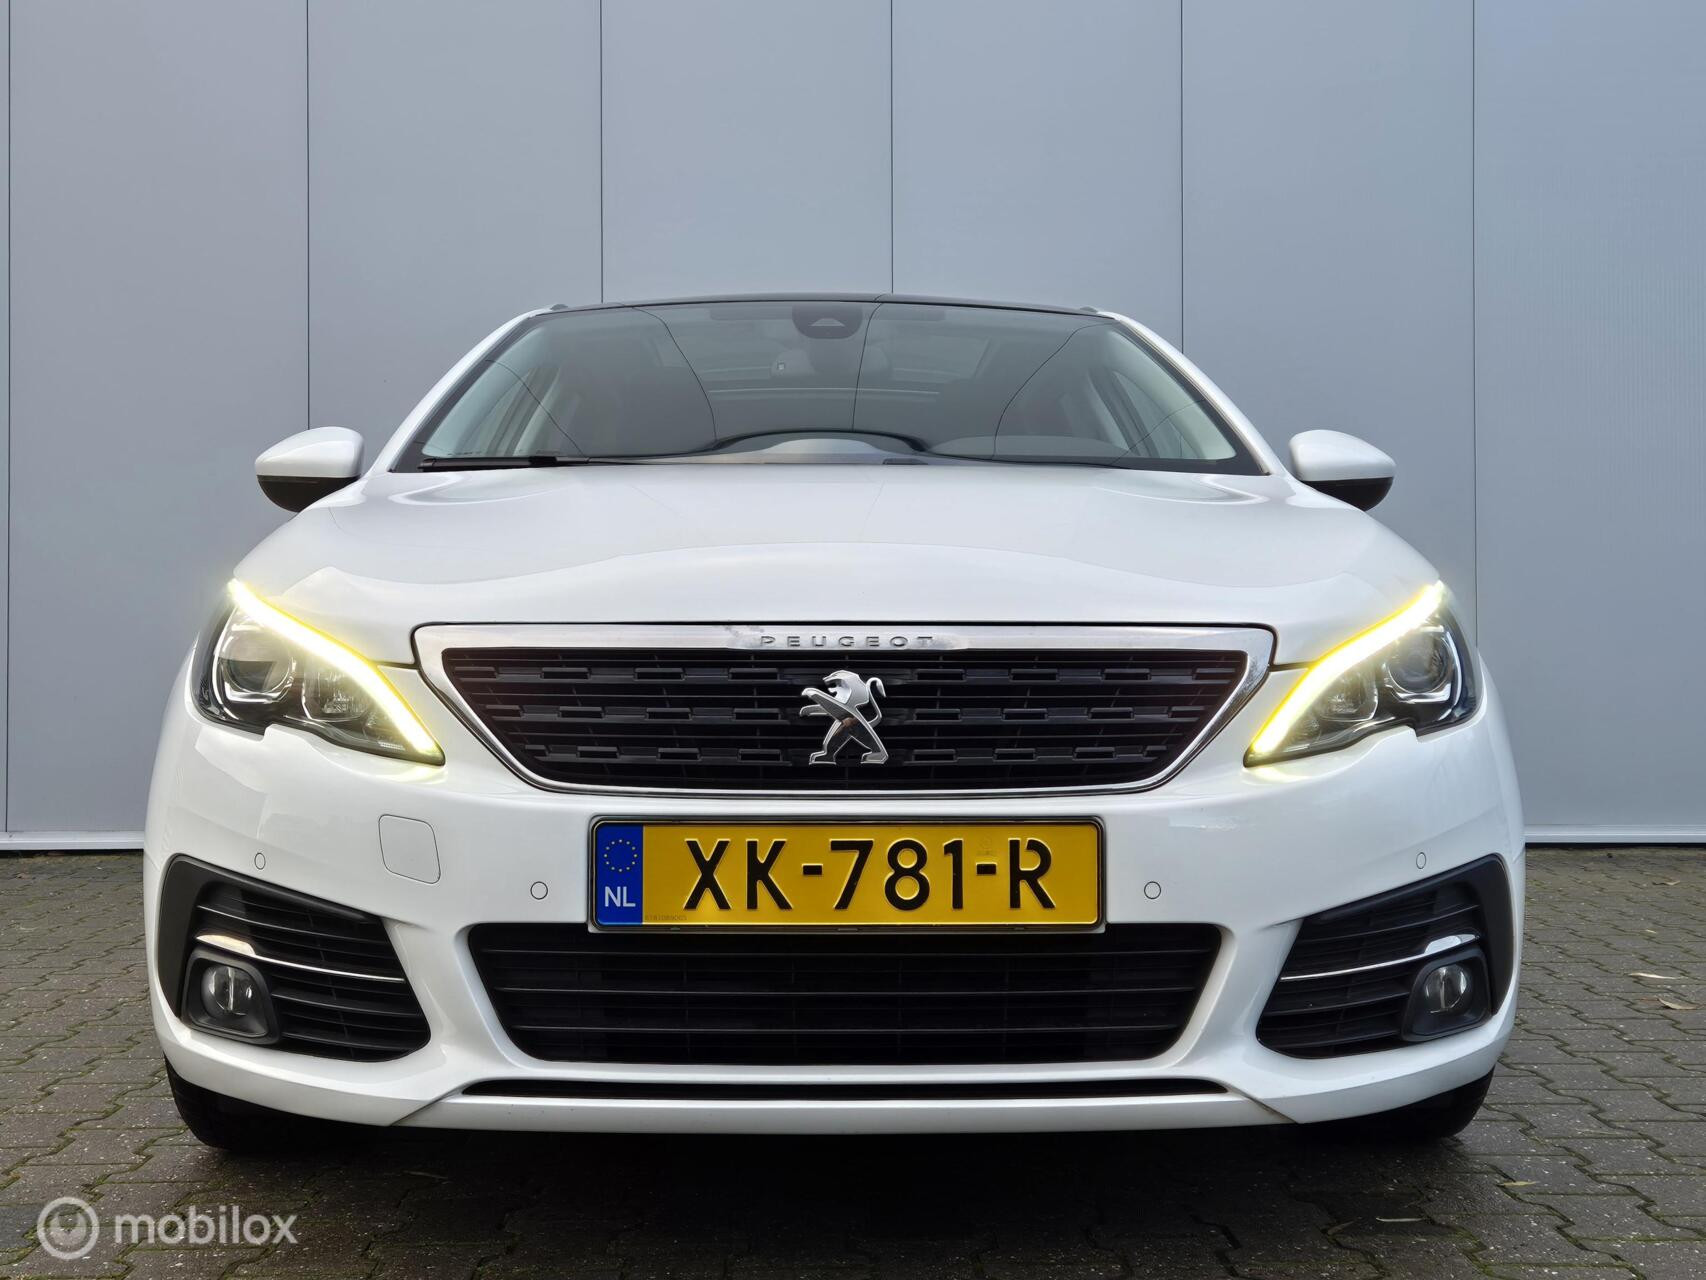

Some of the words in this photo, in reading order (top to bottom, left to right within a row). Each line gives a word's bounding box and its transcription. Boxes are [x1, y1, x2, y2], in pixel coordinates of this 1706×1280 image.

[760, 635, 934, 648] PEUGEOT
[683, 838, 1057, 911] XK-781-R
[604, 886, 636, 908] NL
